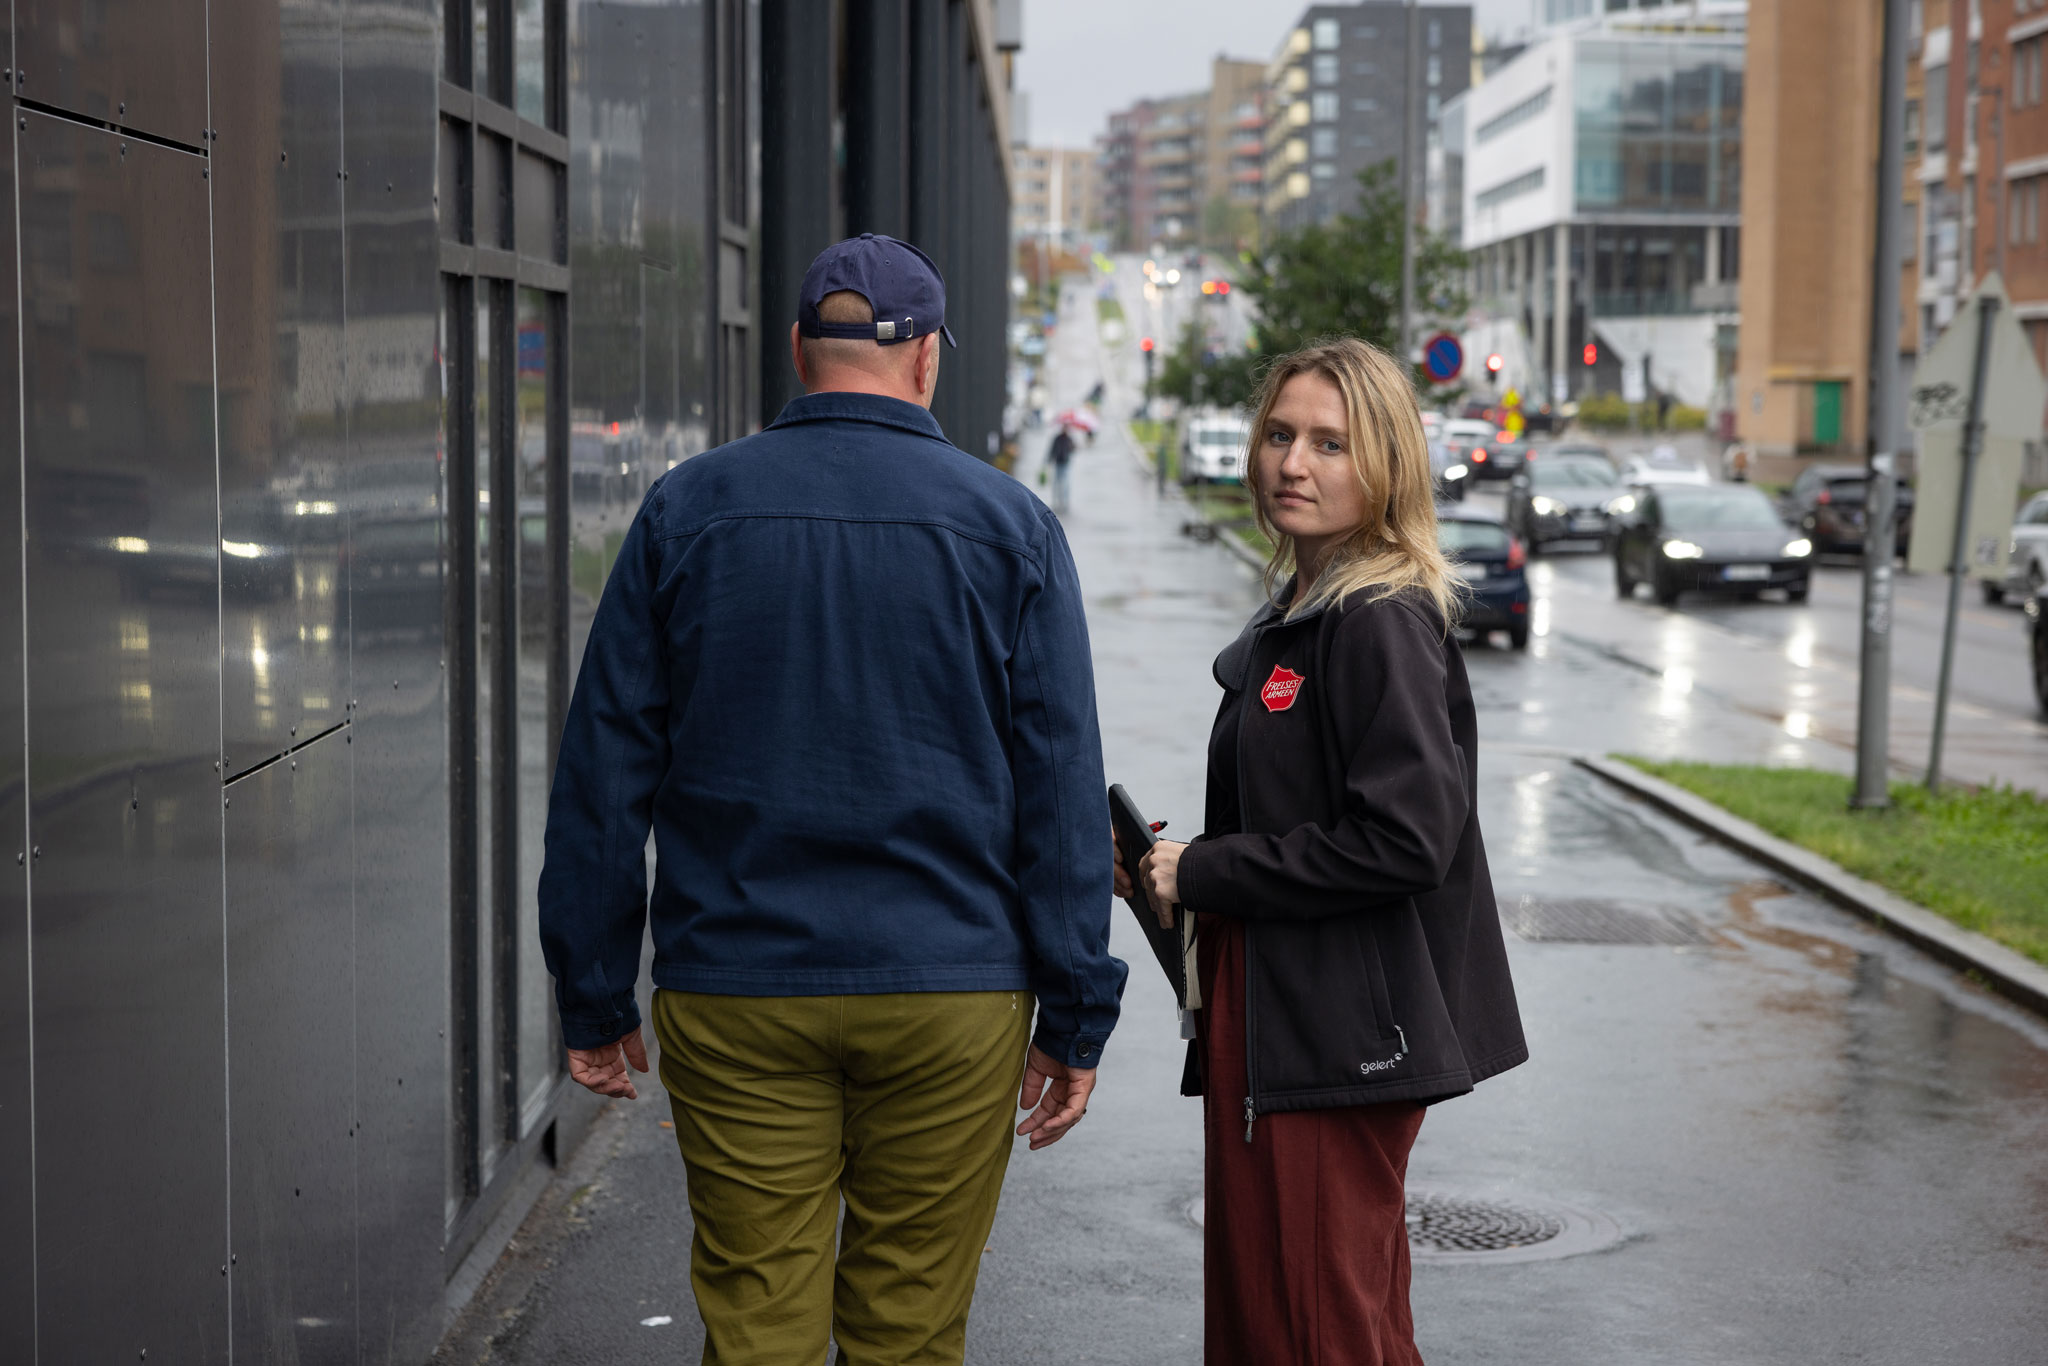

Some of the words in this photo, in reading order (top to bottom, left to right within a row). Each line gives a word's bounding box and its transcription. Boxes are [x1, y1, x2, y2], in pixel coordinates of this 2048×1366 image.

[1266, 679, 1299, 692] FRELSES
[1265, 689, 1295, 700] ARMEEN
[1360, 1058, 1396, 1075] gelert
